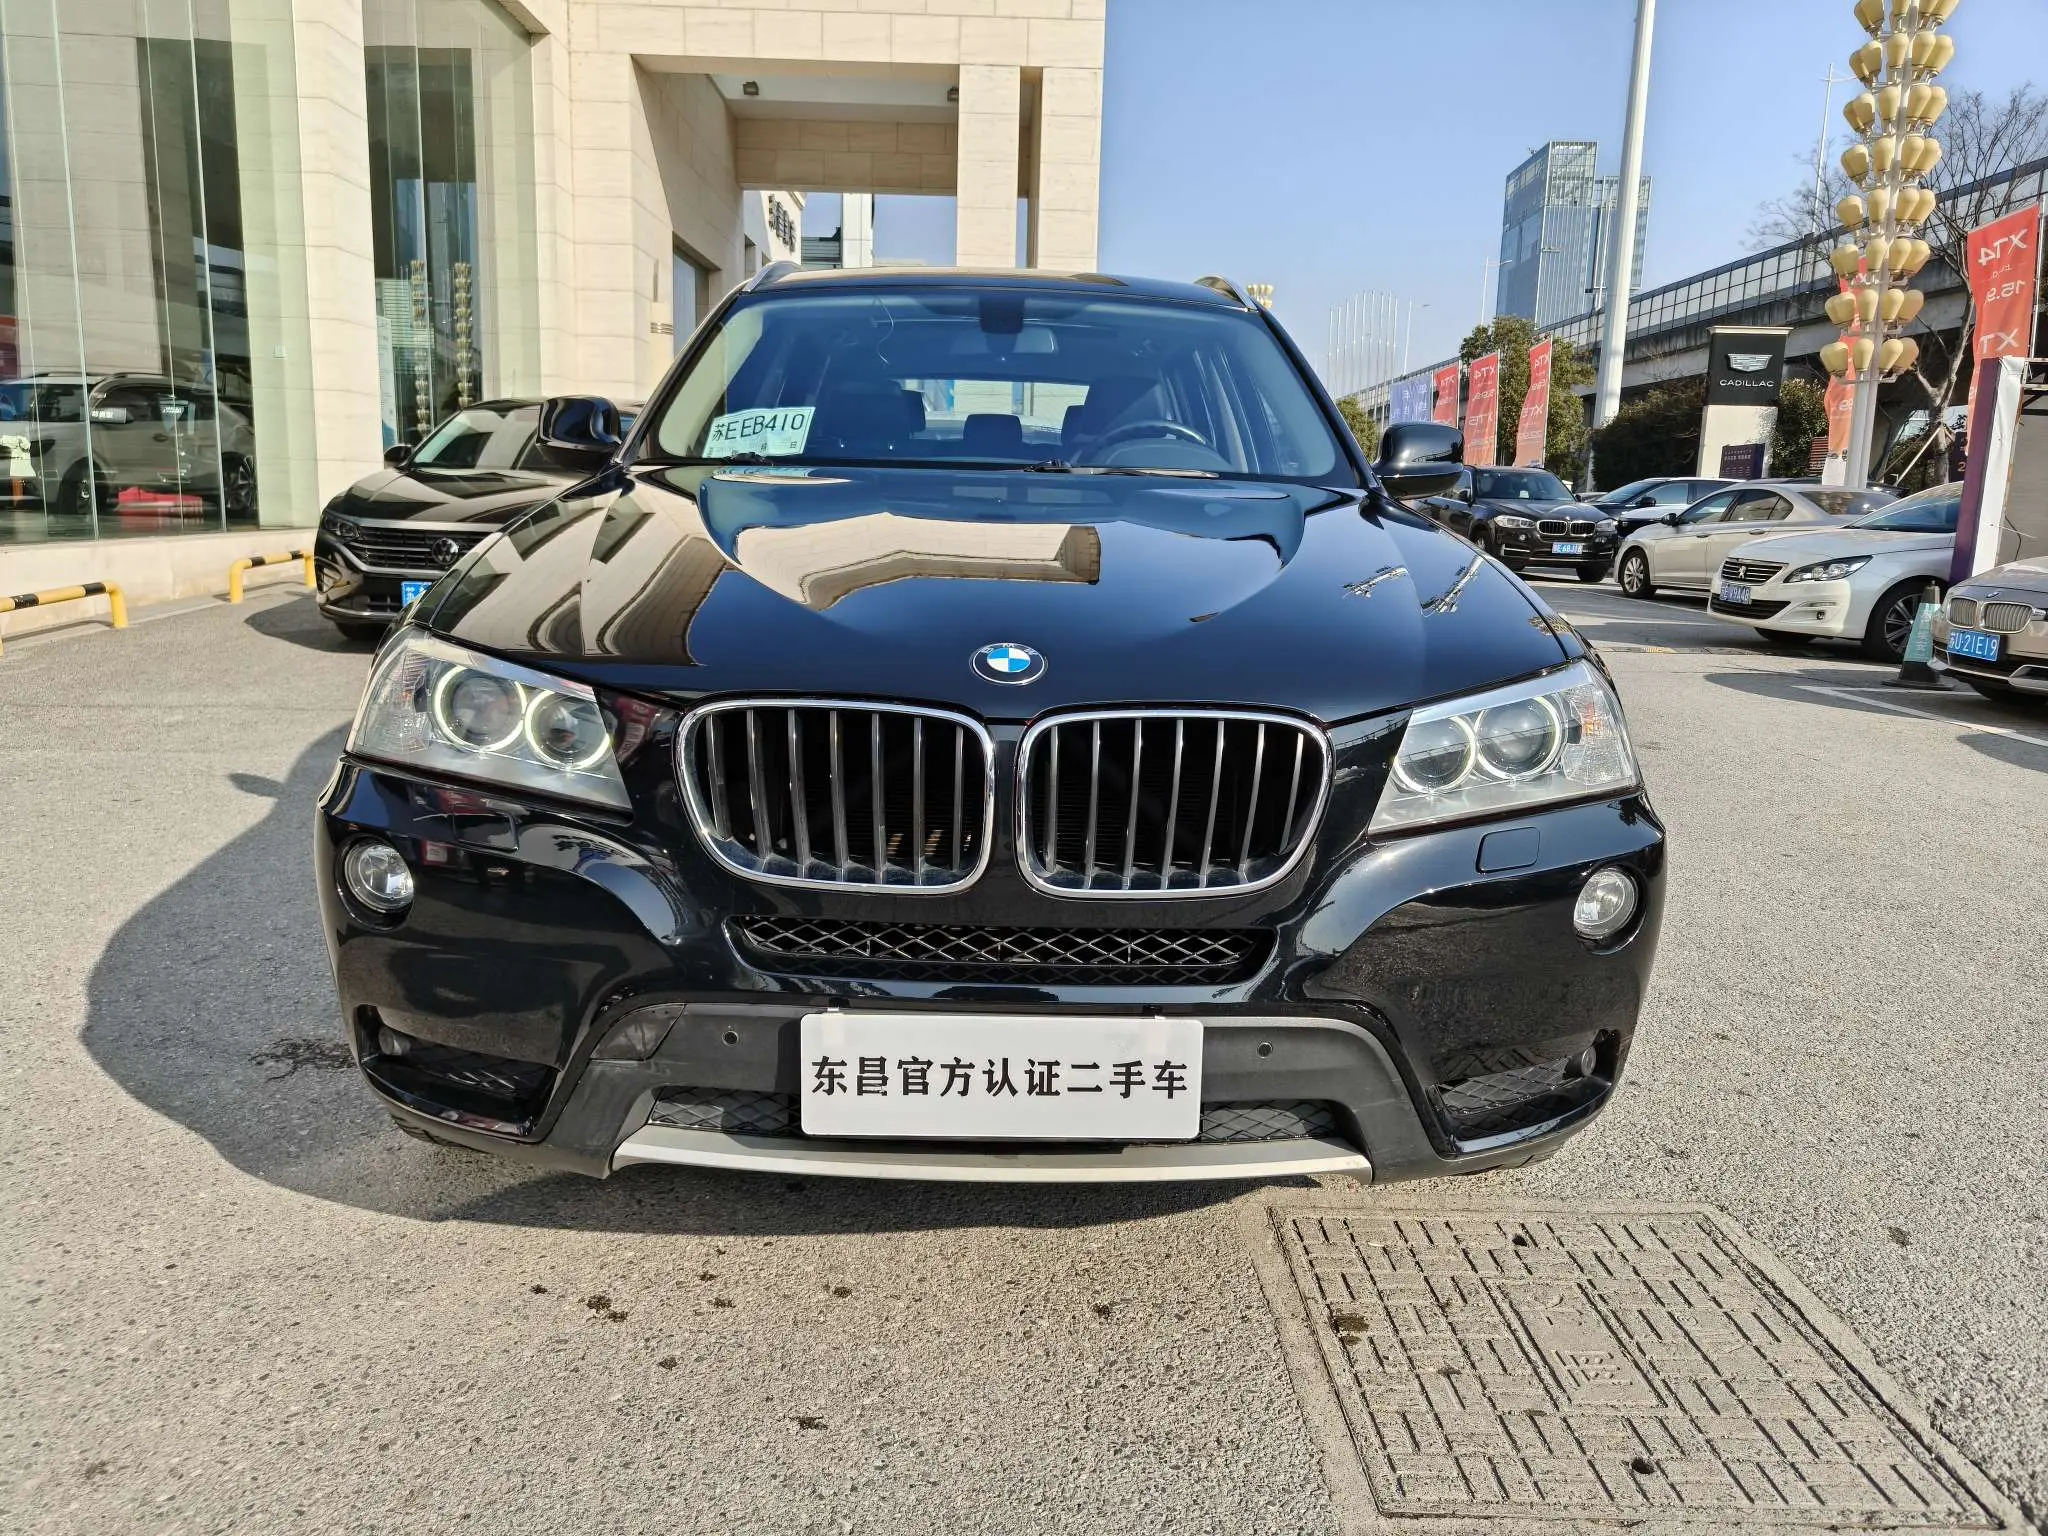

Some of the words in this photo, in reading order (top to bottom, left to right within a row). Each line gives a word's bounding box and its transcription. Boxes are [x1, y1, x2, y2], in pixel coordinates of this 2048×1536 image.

[1719, 379, 1775, 387] CADILLAC
[811, 1055, 1188, 1099] 东昌官方认证二手车
